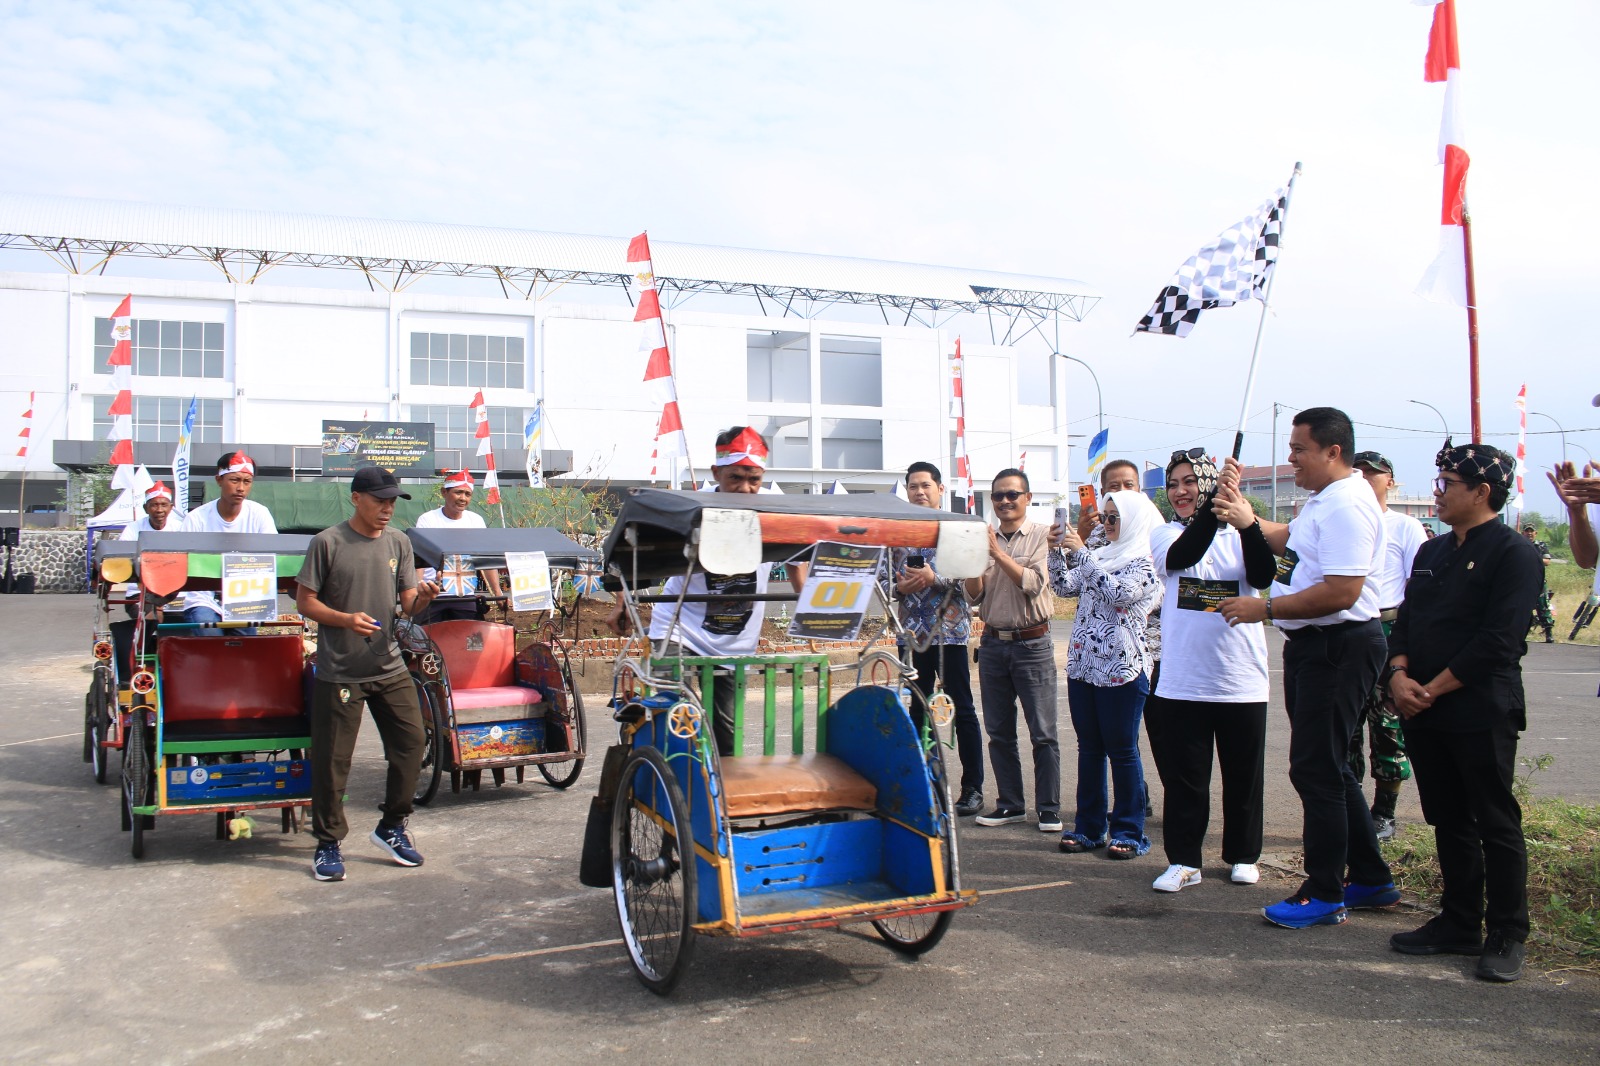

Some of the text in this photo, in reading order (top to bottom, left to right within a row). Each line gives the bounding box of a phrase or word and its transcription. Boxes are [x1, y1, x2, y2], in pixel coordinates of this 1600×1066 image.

[228, 577, 270, 599] 04
[515, 573, 546, 590] 03
[810, 582, 862, 608] 01
